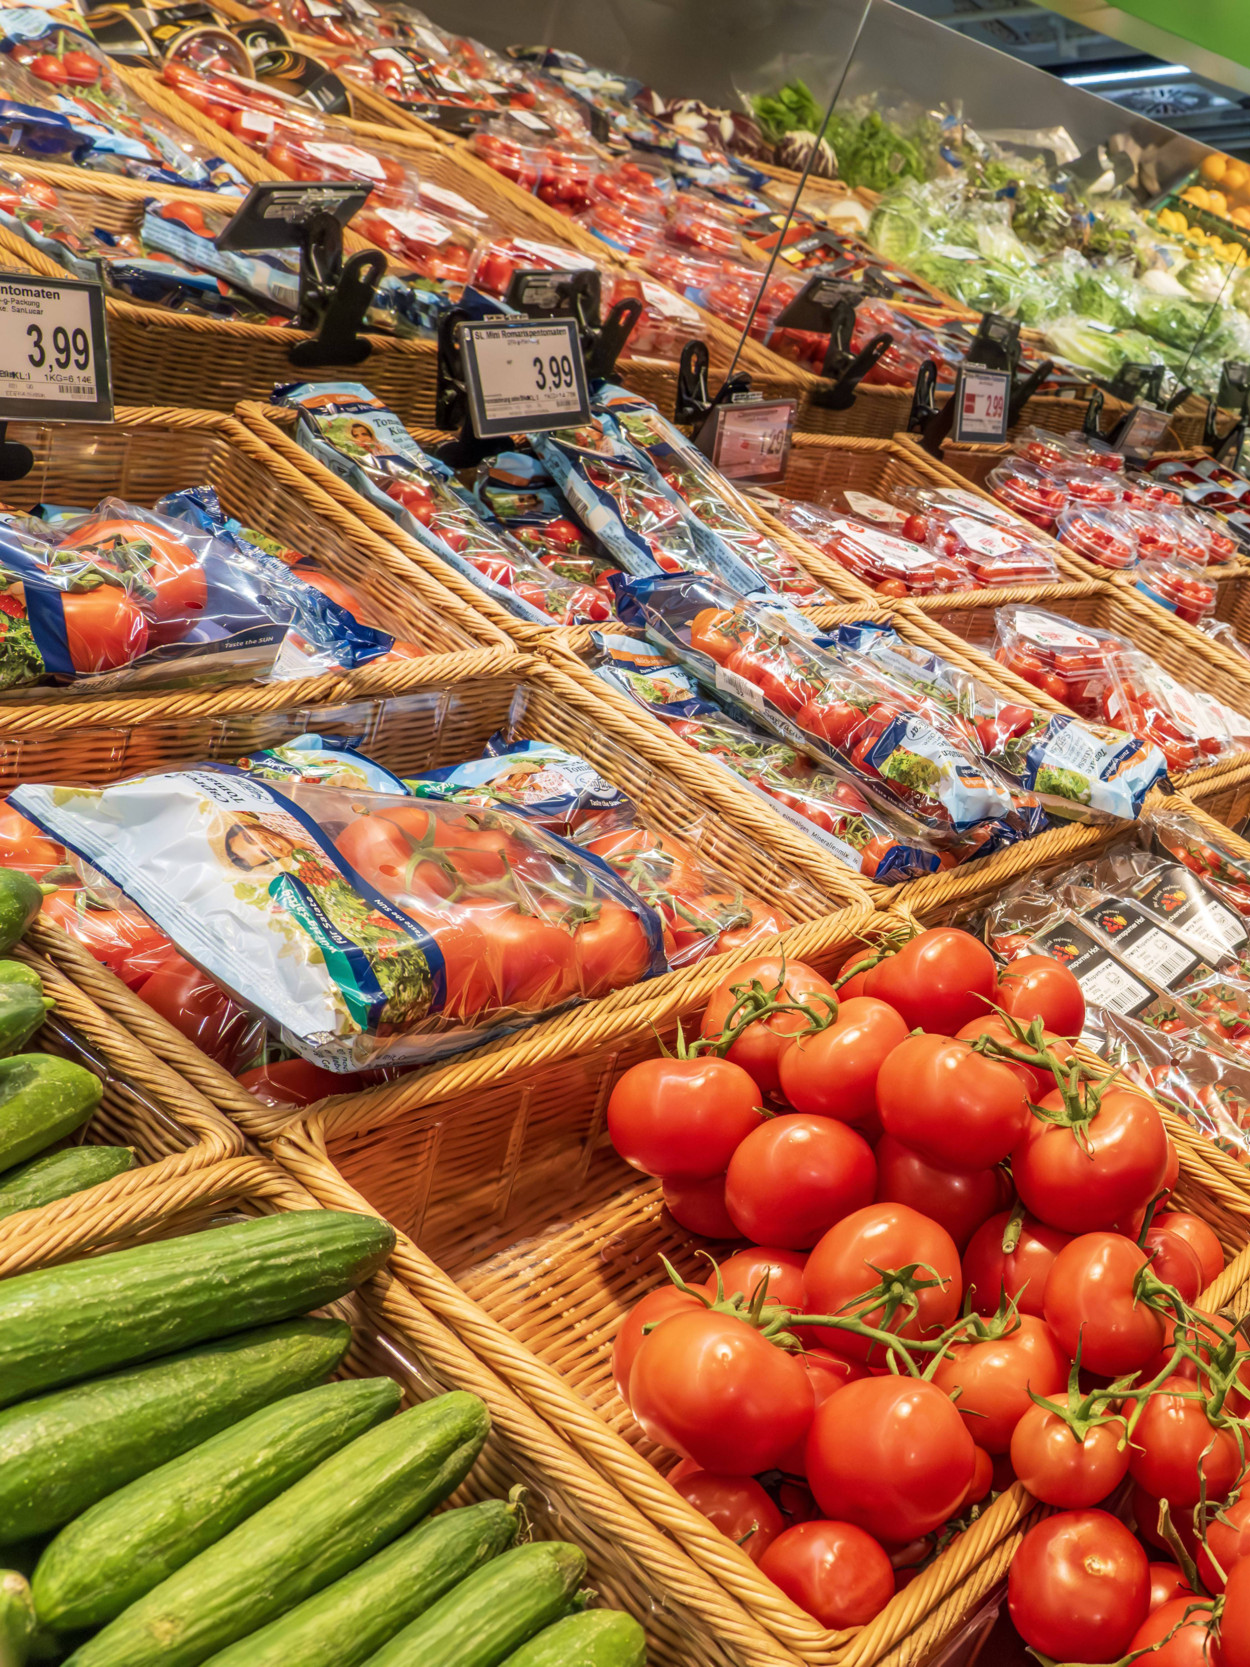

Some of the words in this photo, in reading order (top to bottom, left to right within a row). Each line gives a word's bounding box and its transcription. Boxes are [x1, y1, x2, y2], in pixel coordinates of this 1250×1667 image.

[26, 323, 90, 372] 3,99
[533, 355, 573, 391] 3,99
[224, 641, 244, 649] Taste
[258, 636, 273, 644] SUN
[306, 895, 333, 930] Salate
[374, 899, 392, 912] SUN
[391, 910, 405, 922] the
[404, 920, 424, 938] Taste
[331, 930, 348, 945] für
